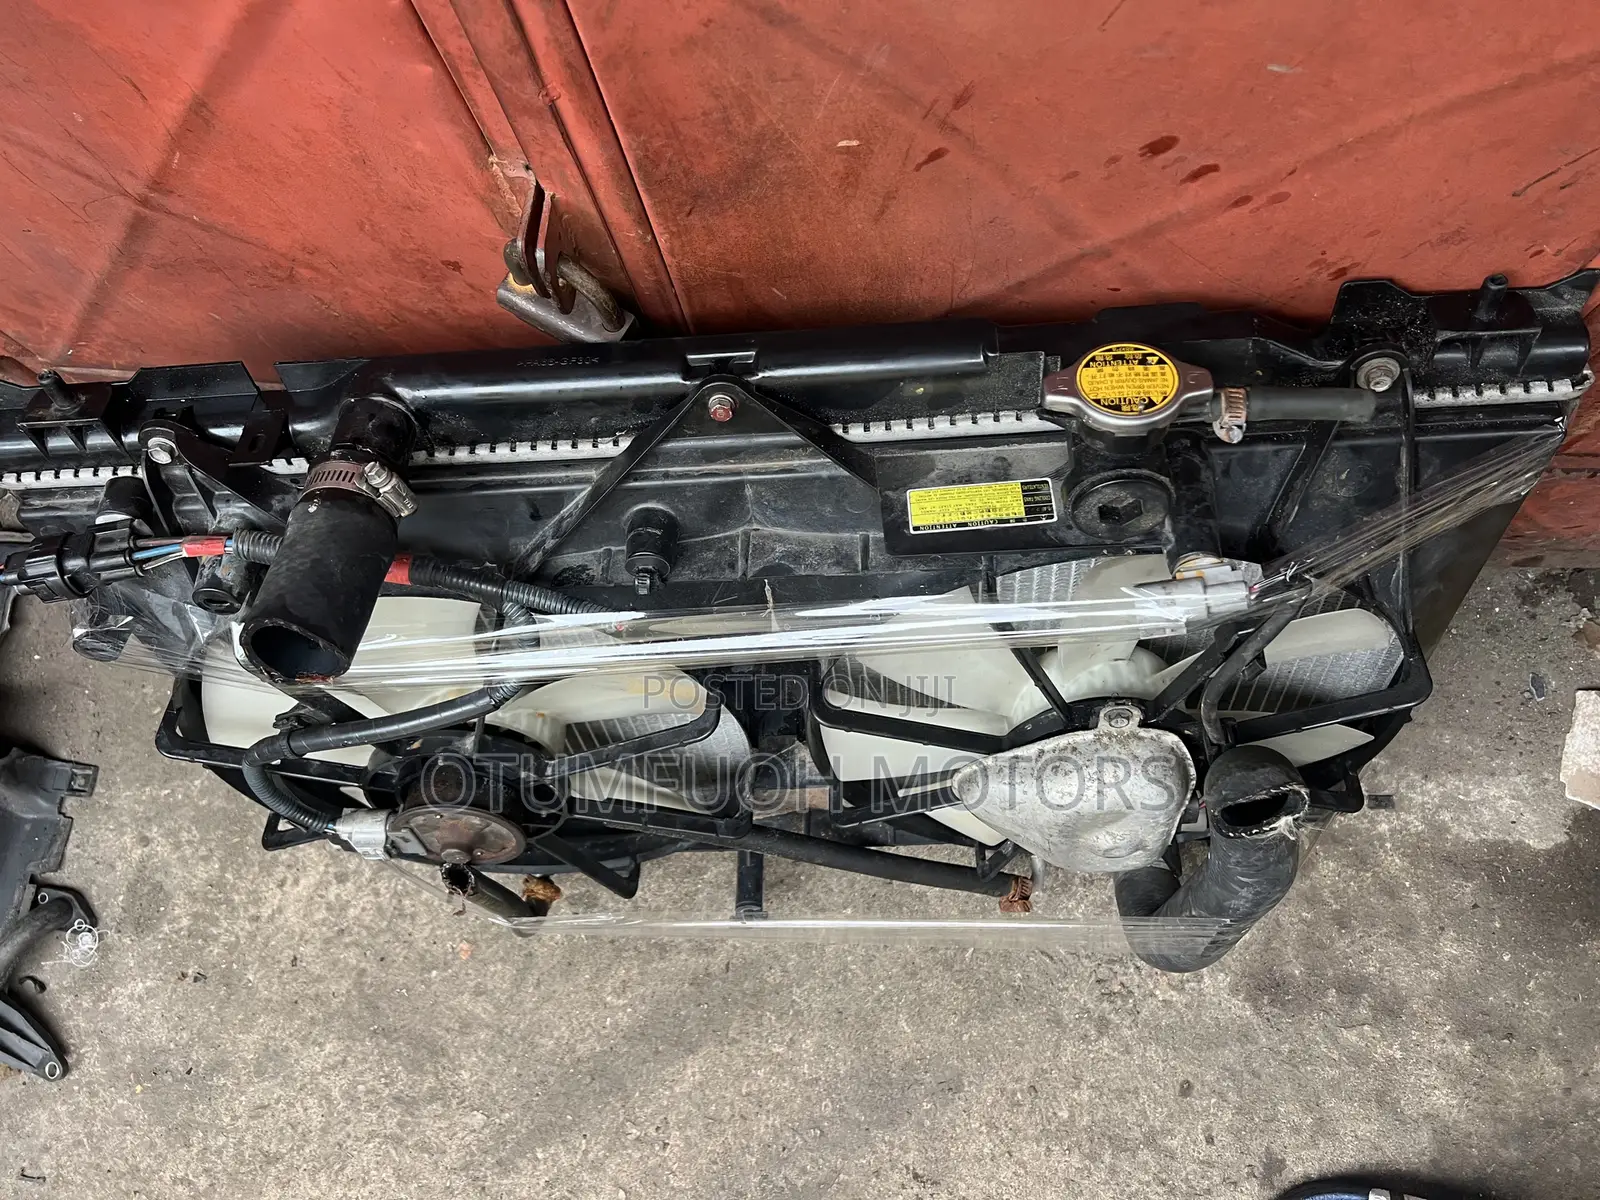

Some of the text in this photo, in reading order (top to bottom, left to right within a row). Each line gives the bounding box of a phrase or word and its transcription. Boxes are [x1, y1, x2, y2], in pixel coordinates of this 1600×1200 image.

[1089, 360, 1139, 368] ATTENTION
[1100, 396, 1149, 406] CAUTION
[919, 519, 999, 531] CAUTION ATTENTION
